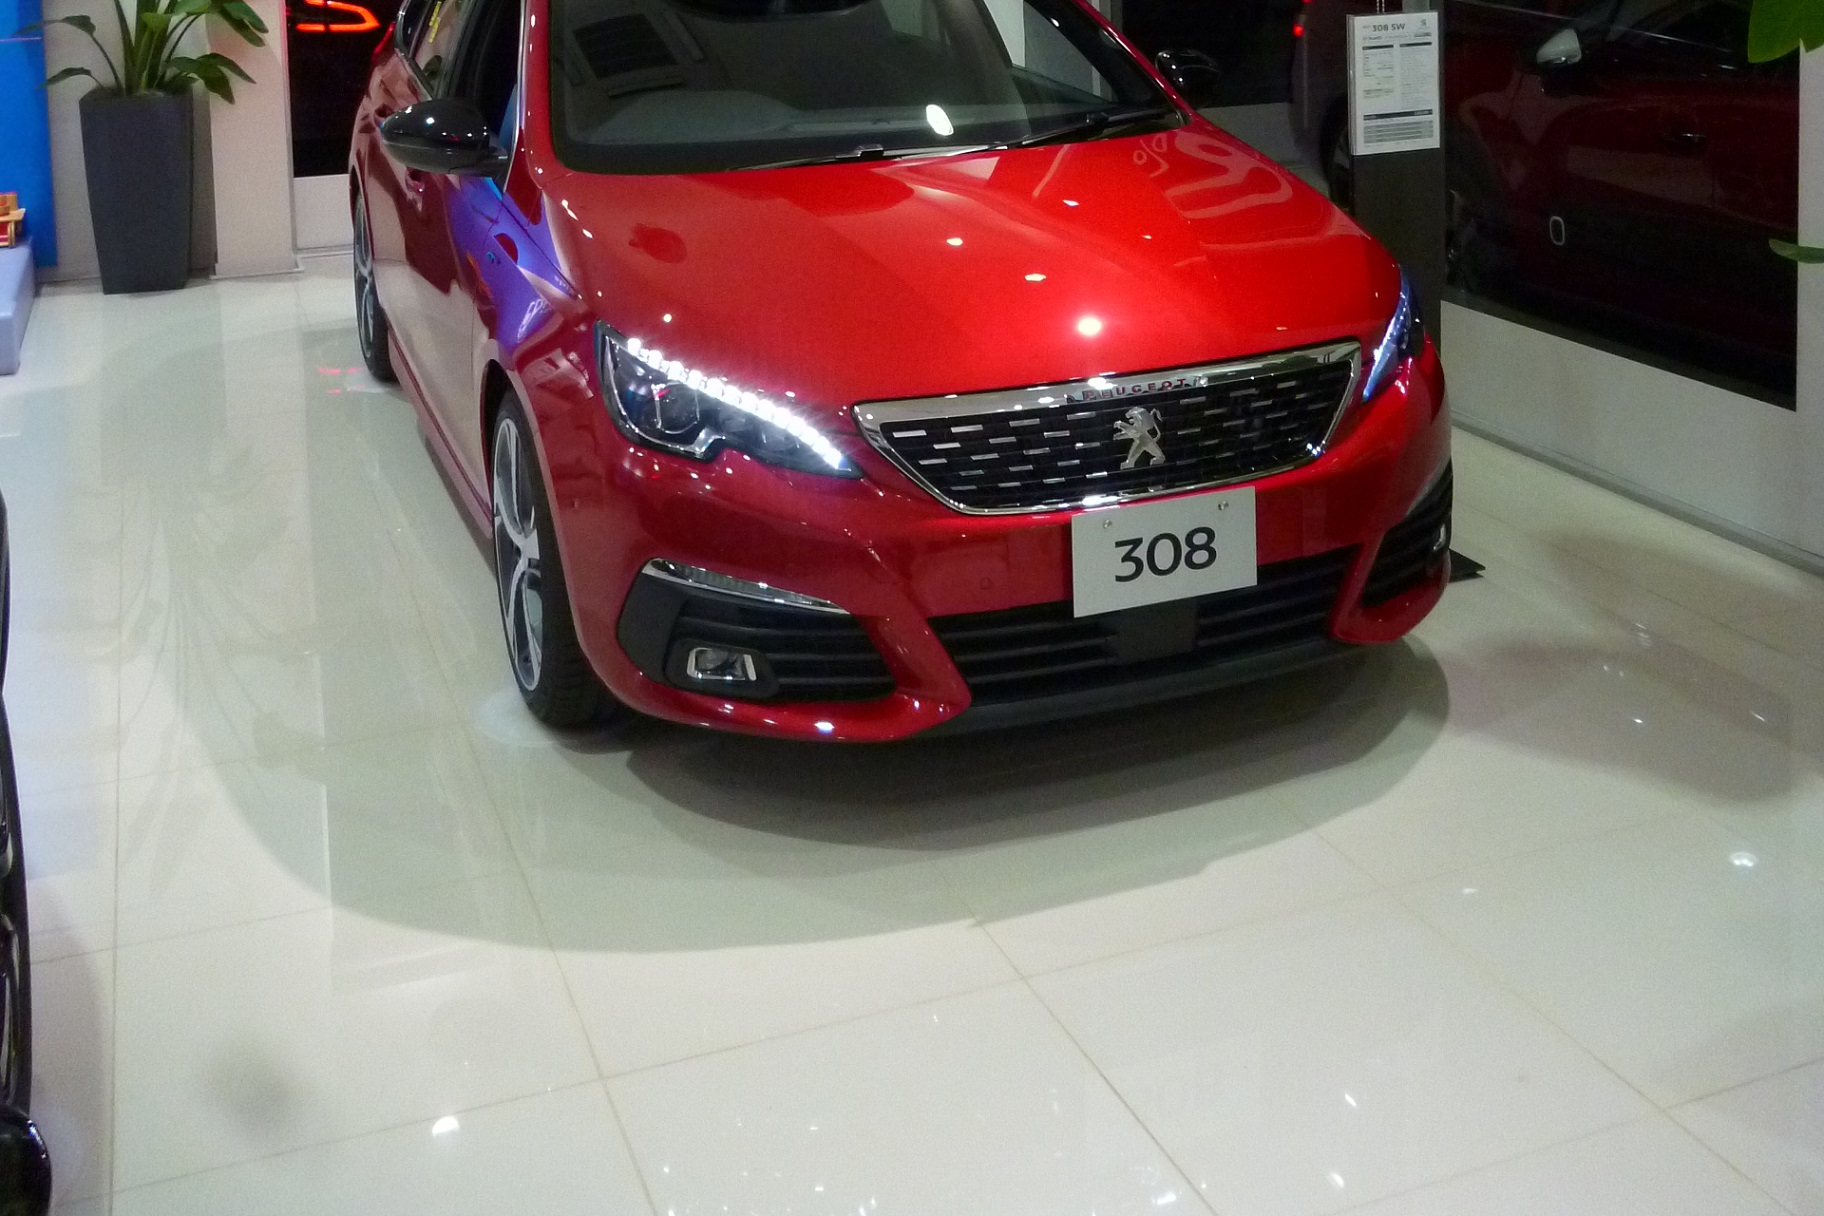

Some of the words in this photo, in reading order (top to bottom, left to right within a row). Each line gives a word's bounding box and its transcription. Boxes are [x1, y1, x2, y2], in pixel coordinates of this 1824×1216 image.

[1372, 24, 1388, 32] 308
[1084, 378, 1187, 400] PEUGEOT
[1114, 526, 1217, 583] 308
